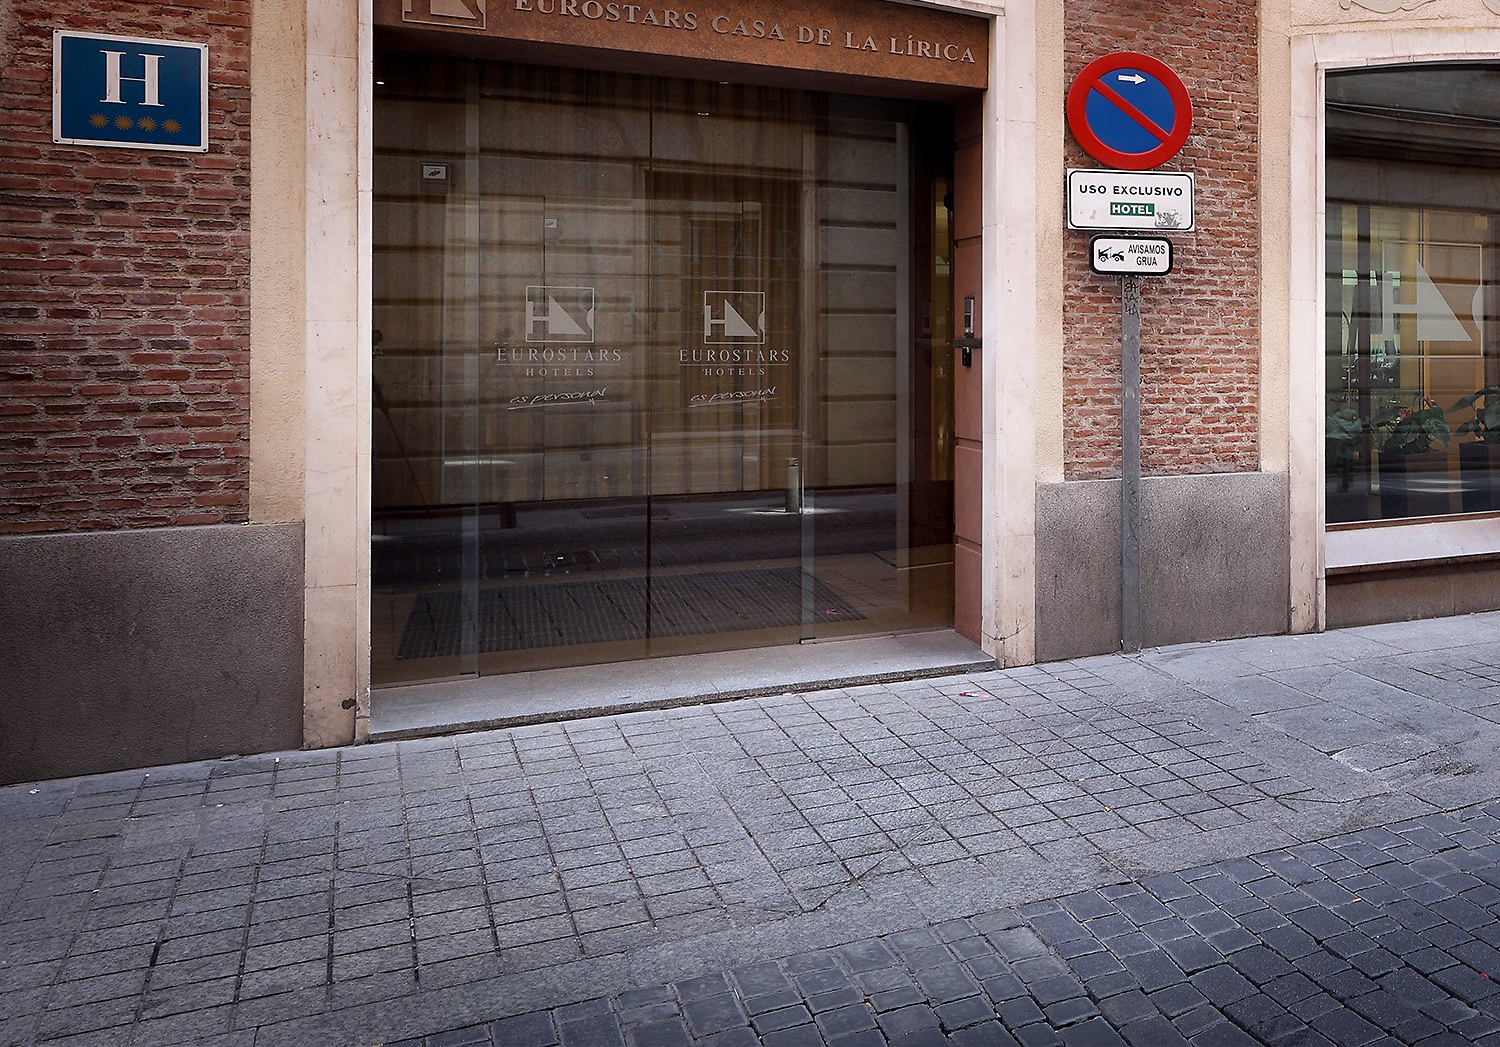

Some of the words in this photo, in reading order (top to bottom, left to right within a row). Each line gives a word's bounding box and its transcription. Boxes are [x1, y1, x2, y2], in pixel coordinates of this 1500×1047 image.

[711, 16, 785, 42] CASA
[797, 25, 832, 46] DE
[844, 31, 878, 52] LA
[889, 35, 976, 64] LÍRICA
[99, 49, 165, 107] H
[1079, 184, 1107, 195] USO
[1113, 185, 1183, 196] EXCLUSIVO
[1111, 203, 1153, 215] HOTEL
[1127, 244, 1166, 255] AVISAMOS
[1136, 256, 1158, 266] GRUA
[497, 347, 622, 362] EUROSTARS
[679, 349, 790, 362] EUROSTARS
[526, 367, 595, 376] HOTELS
[704, 367, 765, 376] HOTELS
[509, 395, 529, 404] es
